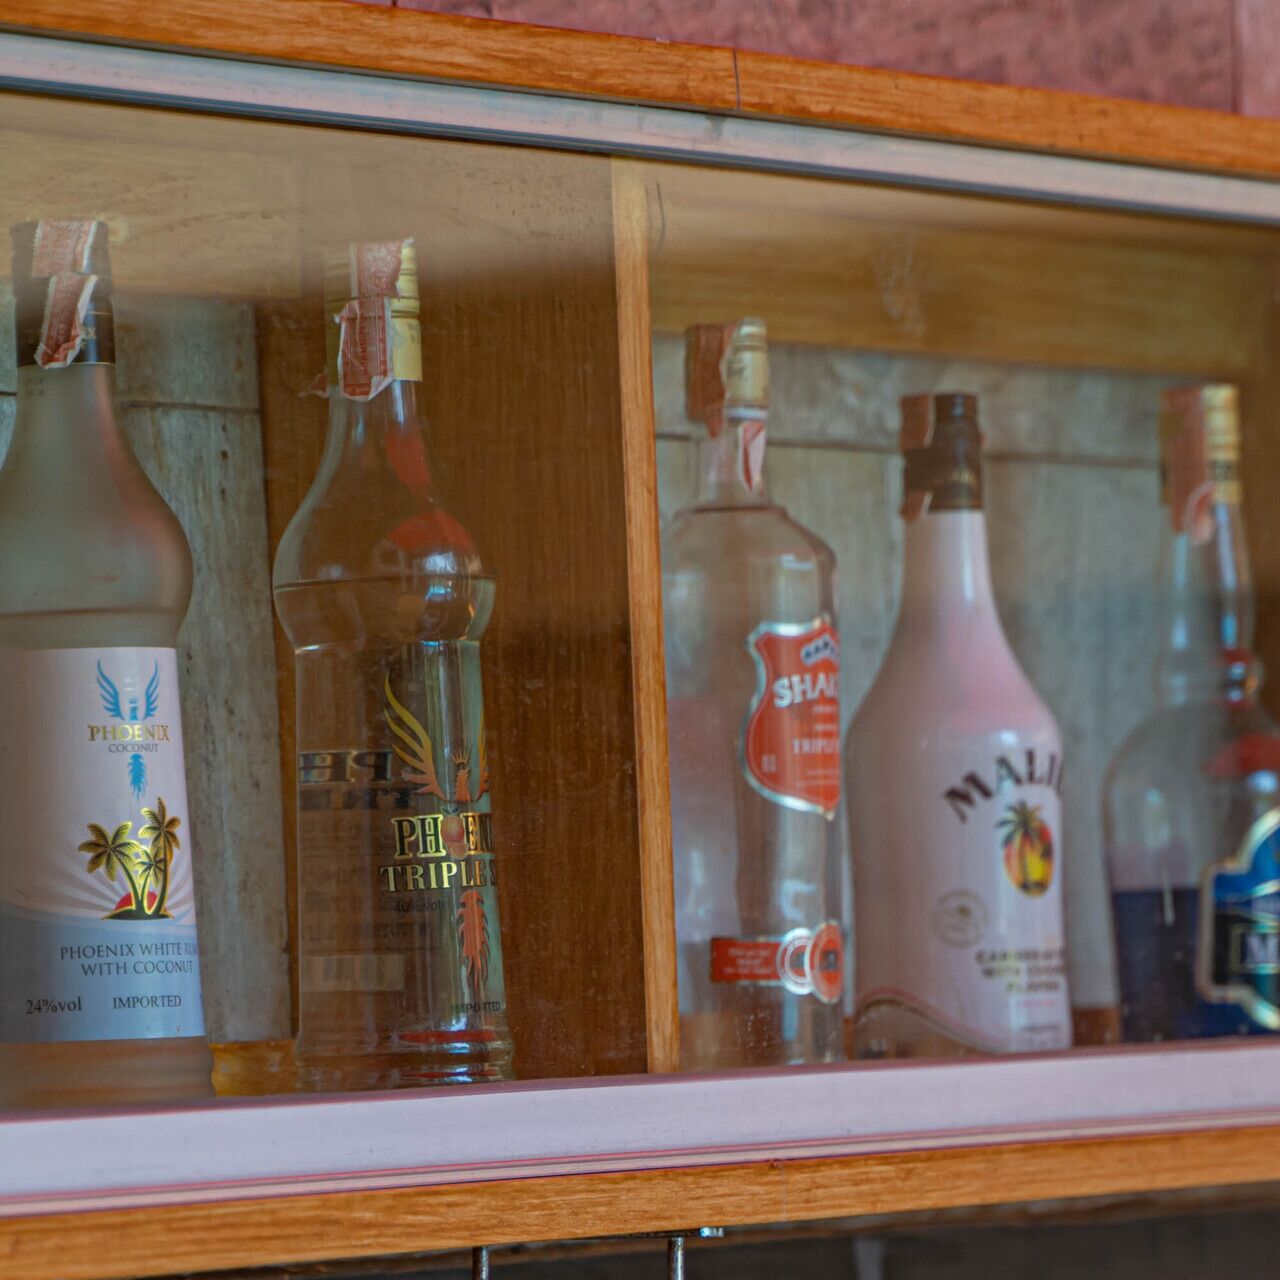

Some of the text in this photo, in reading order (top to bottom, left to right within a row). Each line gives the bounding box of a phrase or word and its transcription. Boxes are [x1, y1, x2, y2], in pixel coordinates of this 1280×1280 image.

[87, 724, 170, 742] PHOENIX
[108, 743, 160, 753] COCONUT
[379, 860, 485, 892] TRIPLE
[60, 943, 136, 960] PHOENIX
[139, 942, 183, 957] WHITE
[81, 960, 193, 977] WITH COCONUT
[25, 995, 182, 1016] 24%vol IMPORTED
